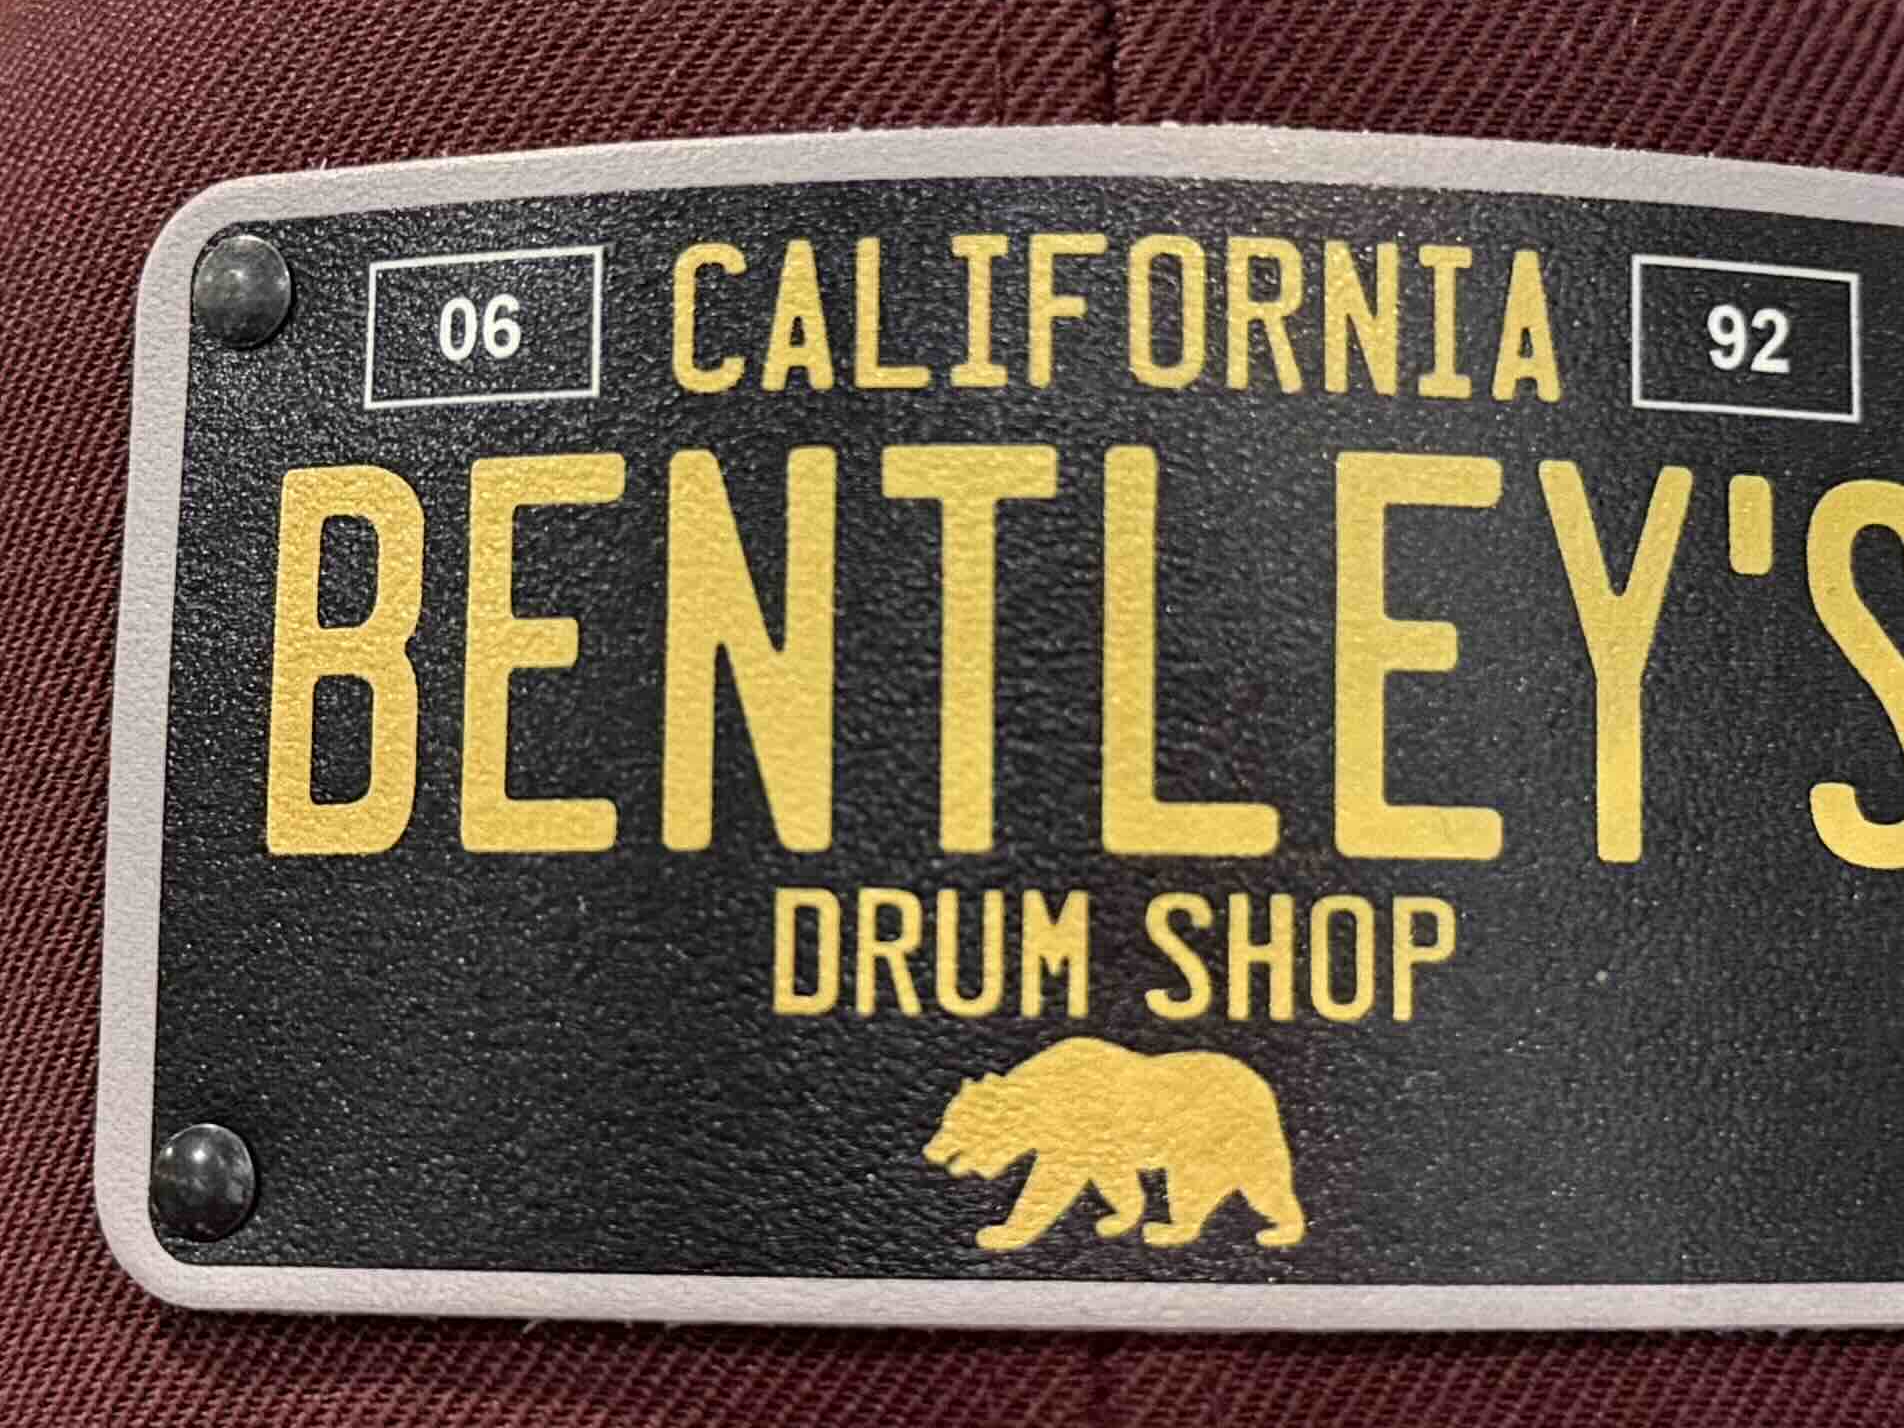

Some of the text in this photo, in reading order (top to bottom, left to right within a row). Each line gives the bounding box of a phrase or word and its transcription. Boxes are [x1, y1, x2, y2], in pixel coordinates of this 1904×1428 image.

[437, 293, 522, 363] 06
[672, 233, 1562, 402] CALIFORNIA
[1706, 304, 1789, 373] 92
[773, 888, 1456, 1021] DRUM SHOP
